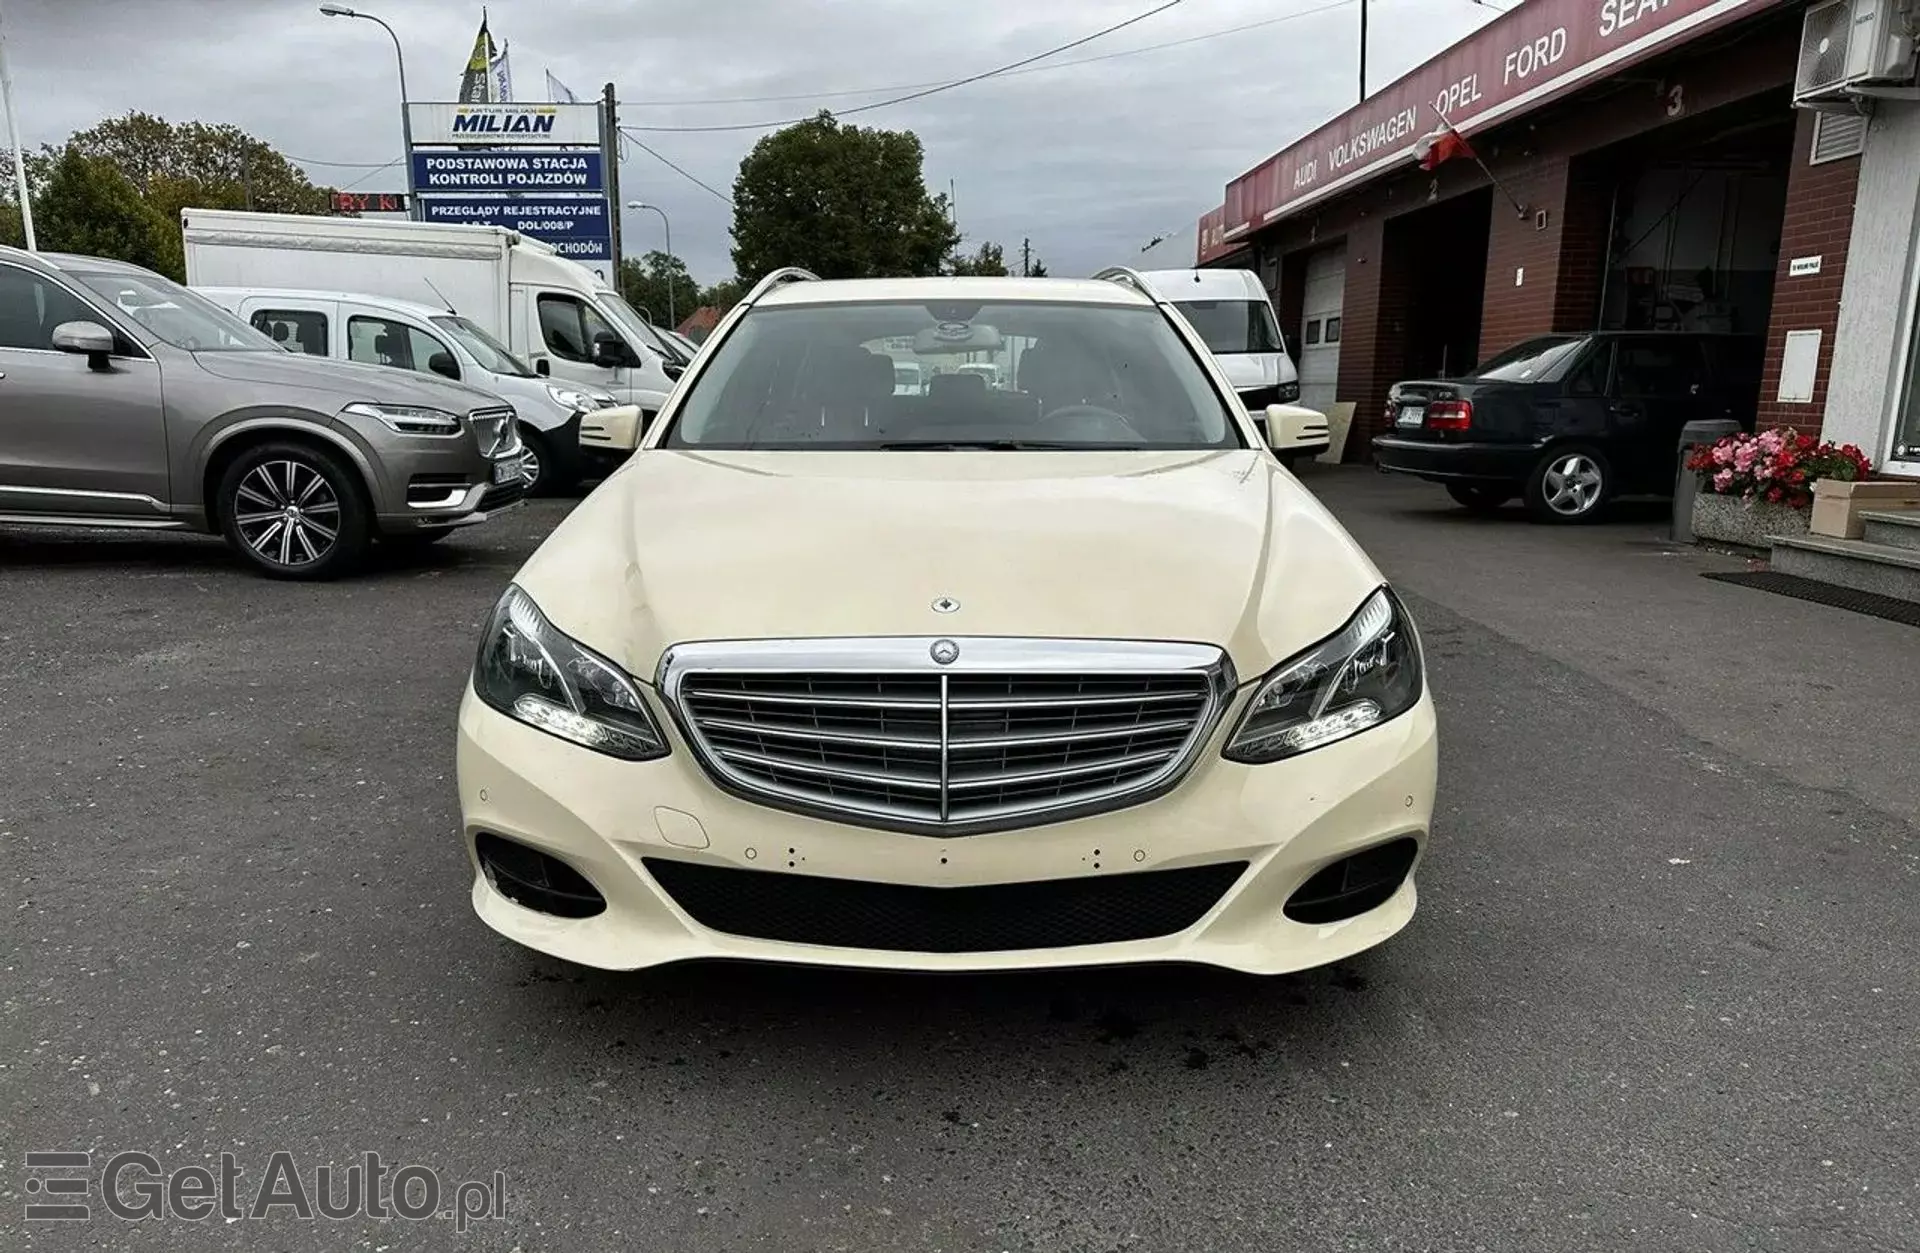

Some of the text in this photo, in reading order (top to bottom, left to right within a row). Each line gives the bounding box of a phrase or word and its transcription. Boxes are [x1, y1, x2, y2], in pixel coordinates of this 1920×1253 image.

[1667, 84, 1684, 116] 3
[1294, 160, 1318, 190] AUDI
[1328, 105, 1417, 172] VOLKSWAGEN
[1436, 73, 1482, 116] OPEL
[1504, 26, 1567, 86] FORD
[453, 114, 555, 132] MILIAN
[426, 157, 587, 169] PODSTAWOWA STACJA
[429, 172, 587, 185] KONTROLI POJAZDÓW
[431, 206, 601, 217] PRZEGLĄDY REJESTRACYJNE
